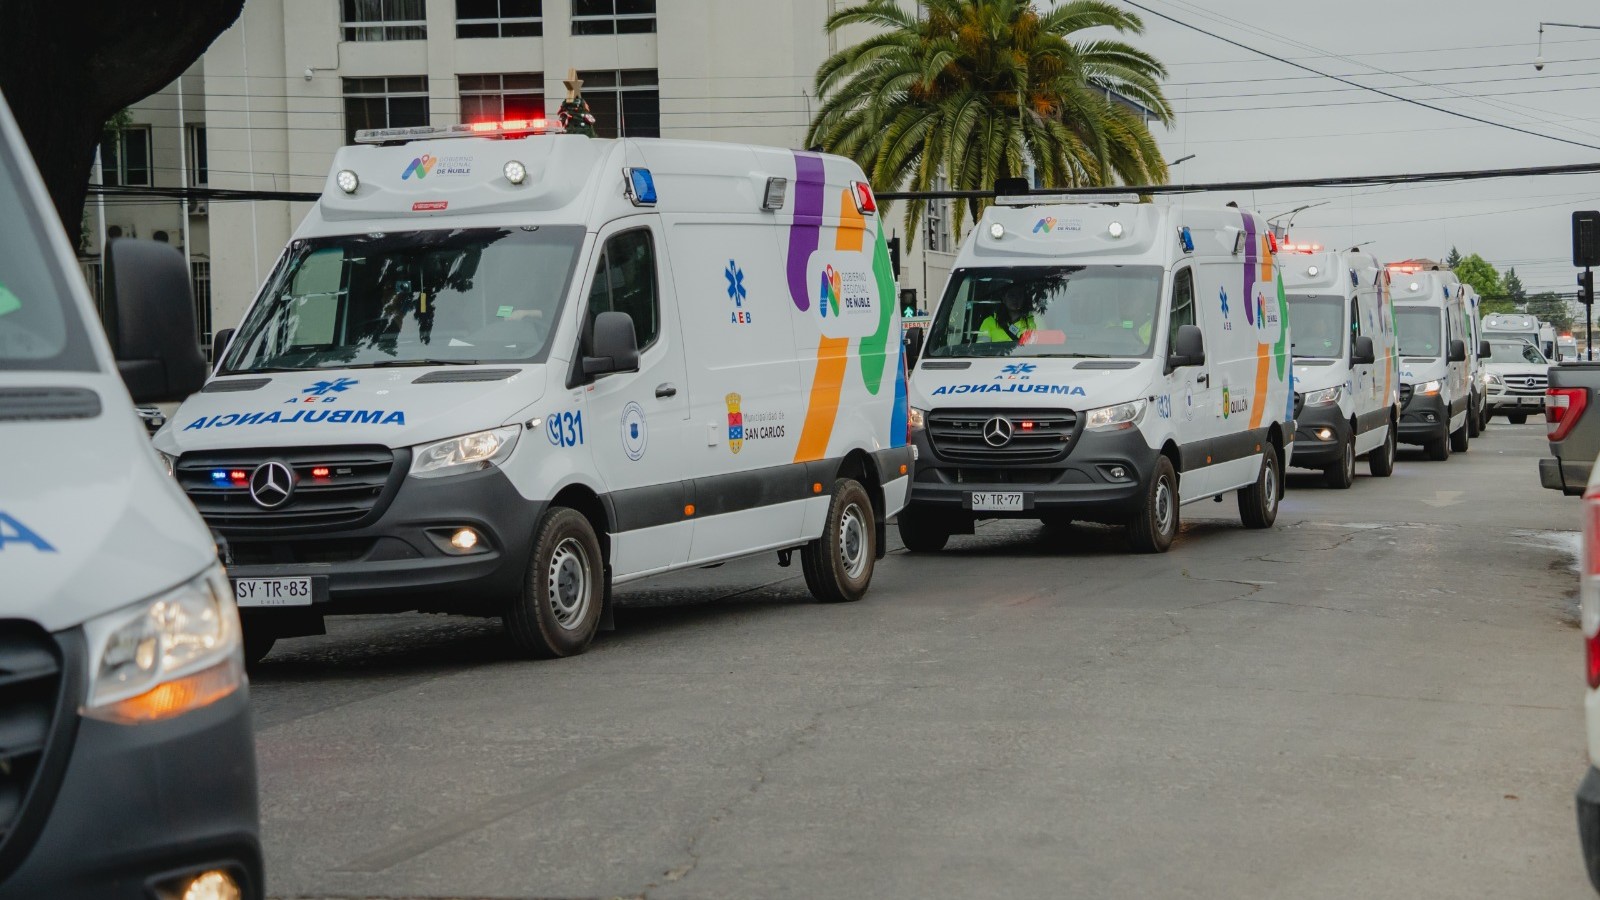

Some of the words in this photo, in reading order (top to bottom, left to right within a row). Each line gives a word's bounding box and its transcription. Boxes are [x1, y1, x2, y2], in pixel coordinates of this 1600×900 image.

[842, 272, 866, 282] GOBIERNO
[843, 284, 868, 294] REGIONAL
[846, 298, 853, 308] DE
[854, 294, 870, 308] ÑUBLE
[554, 410, 583, 447] 131
[745, 428, 758, 440] SAN
[760, 425, 785, 438] CARLOS
